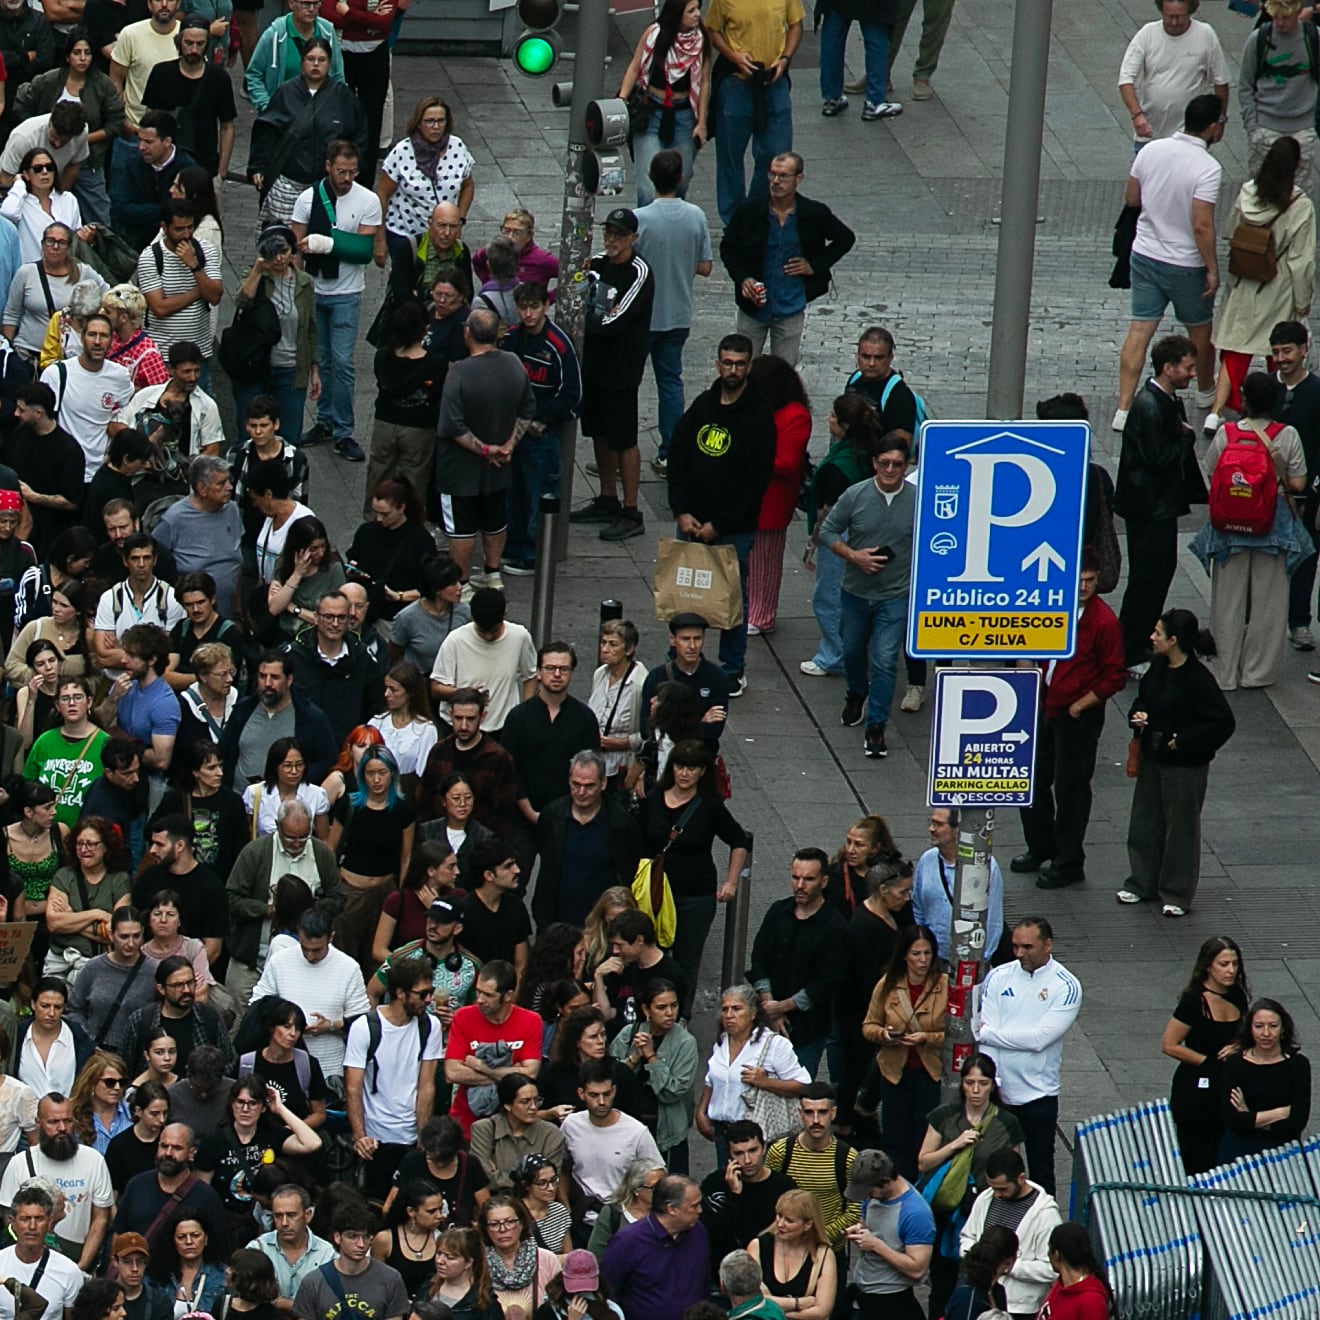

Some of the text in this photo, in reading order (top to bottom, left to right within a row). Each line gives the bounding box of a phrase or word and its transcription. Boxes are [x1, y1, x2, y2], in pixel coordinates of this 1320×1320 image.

[947, 454, 1056, 582] P
[926, 588, 1064, 606] Público 24 H
[924, 616, 966, 628] LUNA
[980, 616, 1064, 628] TUDESCOS
[959, 633, 1027, 646] C/ SILVA
[939, 675, 1018, 764] P
[964, 743, 1015, 753] ABIERTO
[964, 753, 982, 764] 24
[937, 766, 1029, 777] SIN MULTAS
[935, 780, 1028, 789] PARKING CALLAO
[1017, 792, 1026, 801] 3
[56, 1178, 85, 1189] Bears
